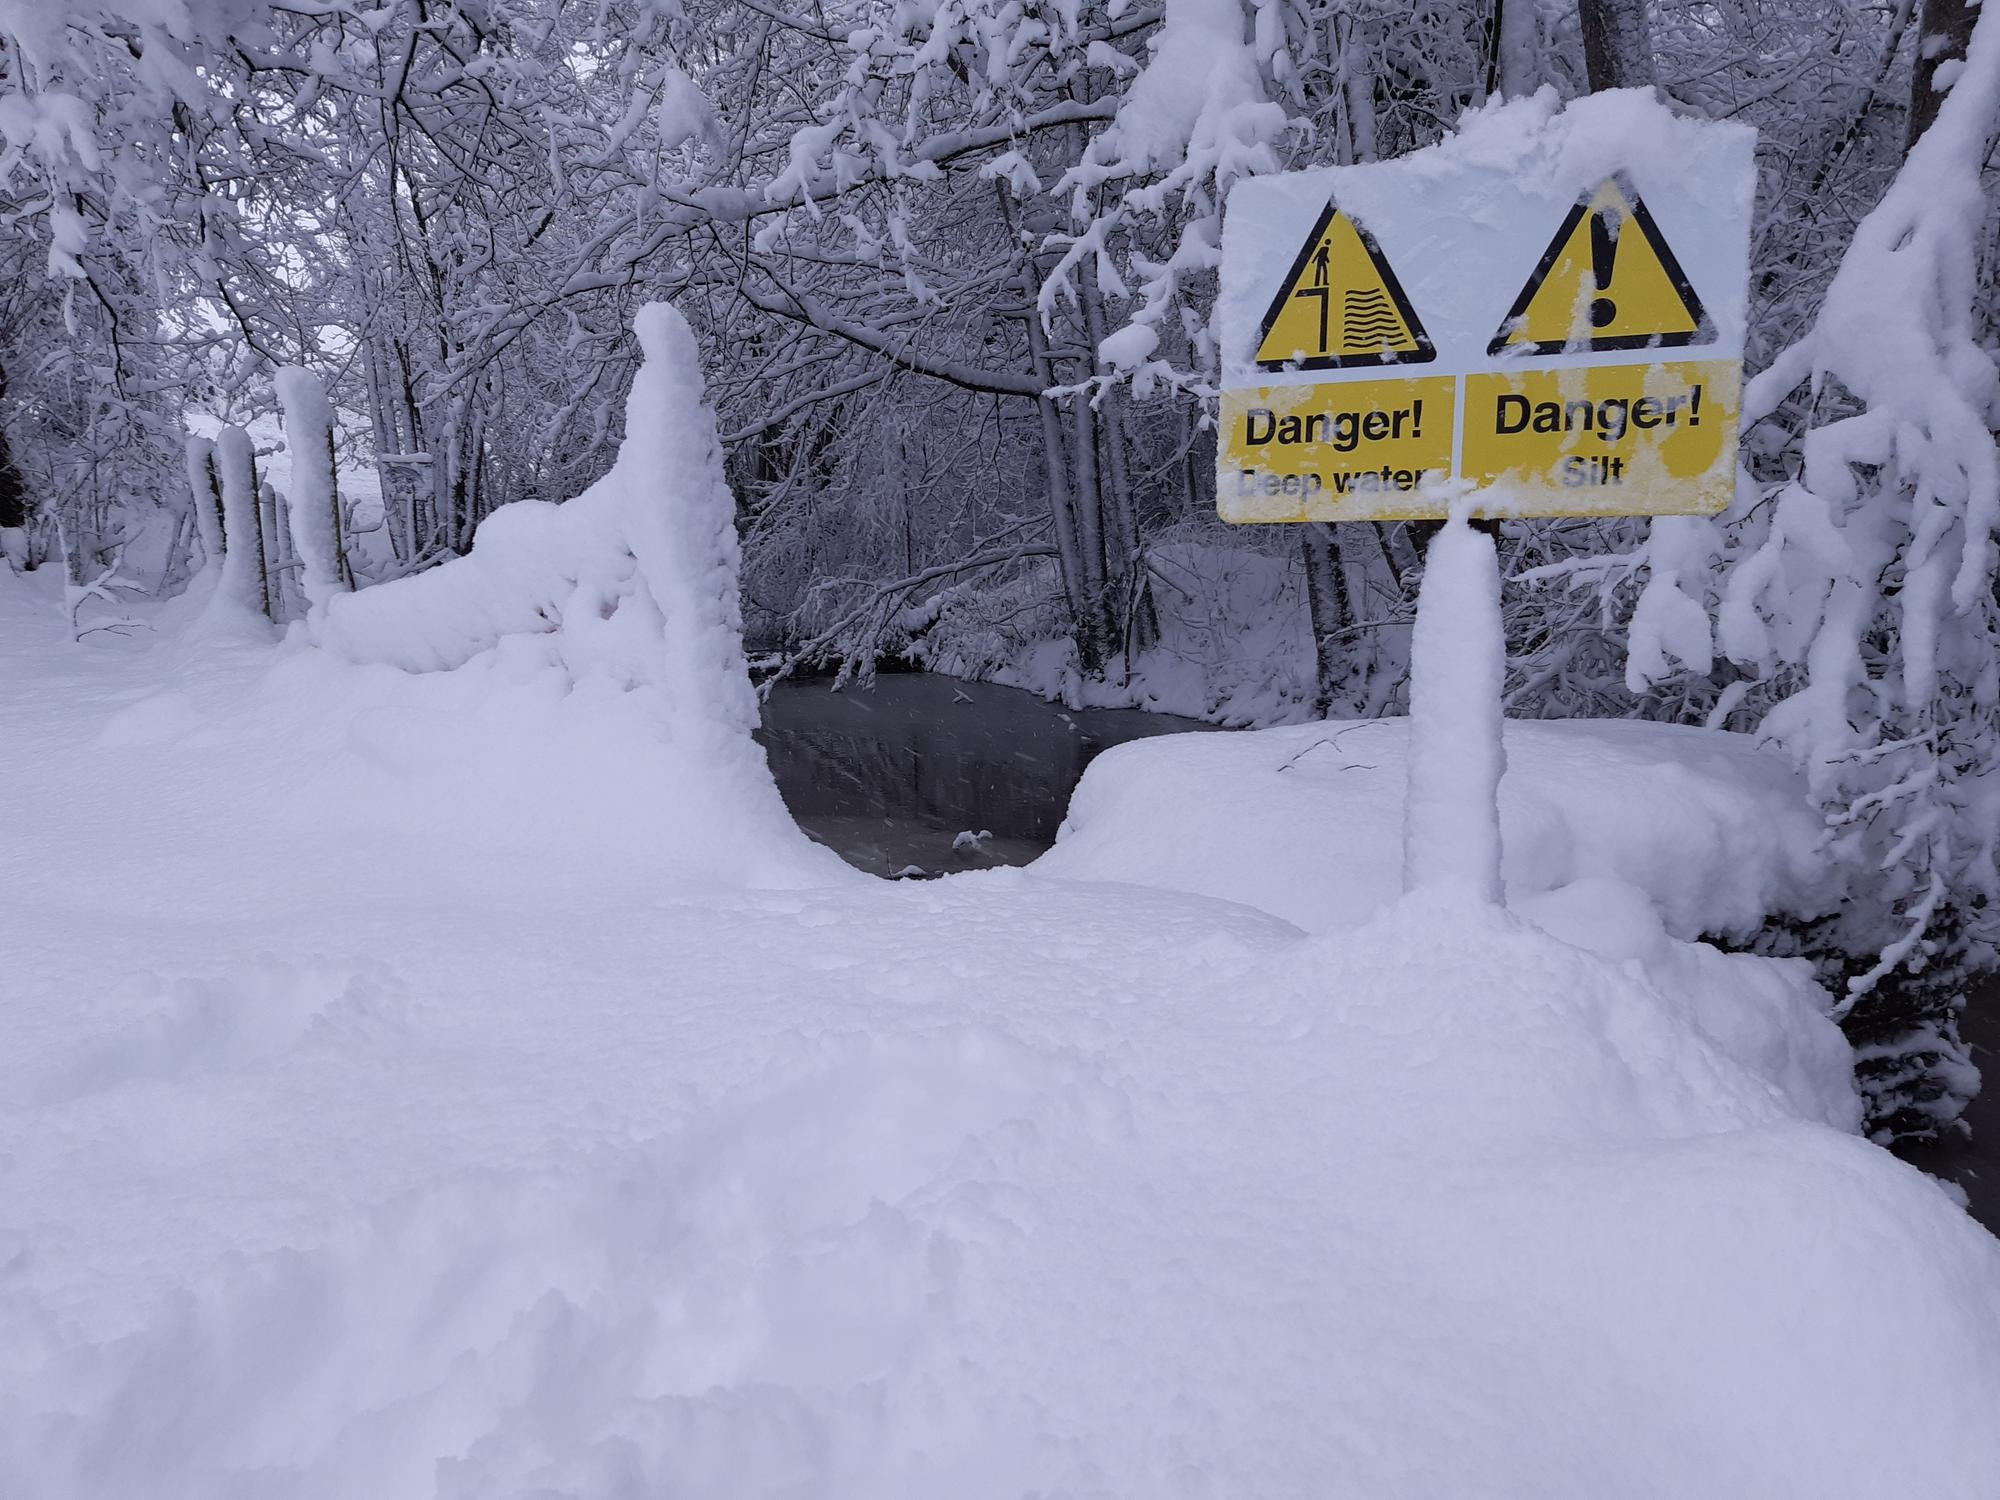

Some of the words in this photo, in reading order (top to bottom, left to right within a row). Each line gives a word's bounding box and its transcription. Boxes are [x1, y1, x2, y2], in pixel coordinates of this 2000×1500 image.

[1246, 400, 1423, 451] Danger!
[1496, 384, 1702, 441] Danger!
[1237, 468, 1322, 503] Deep
[1562, 455, 1624, 487] Silt
